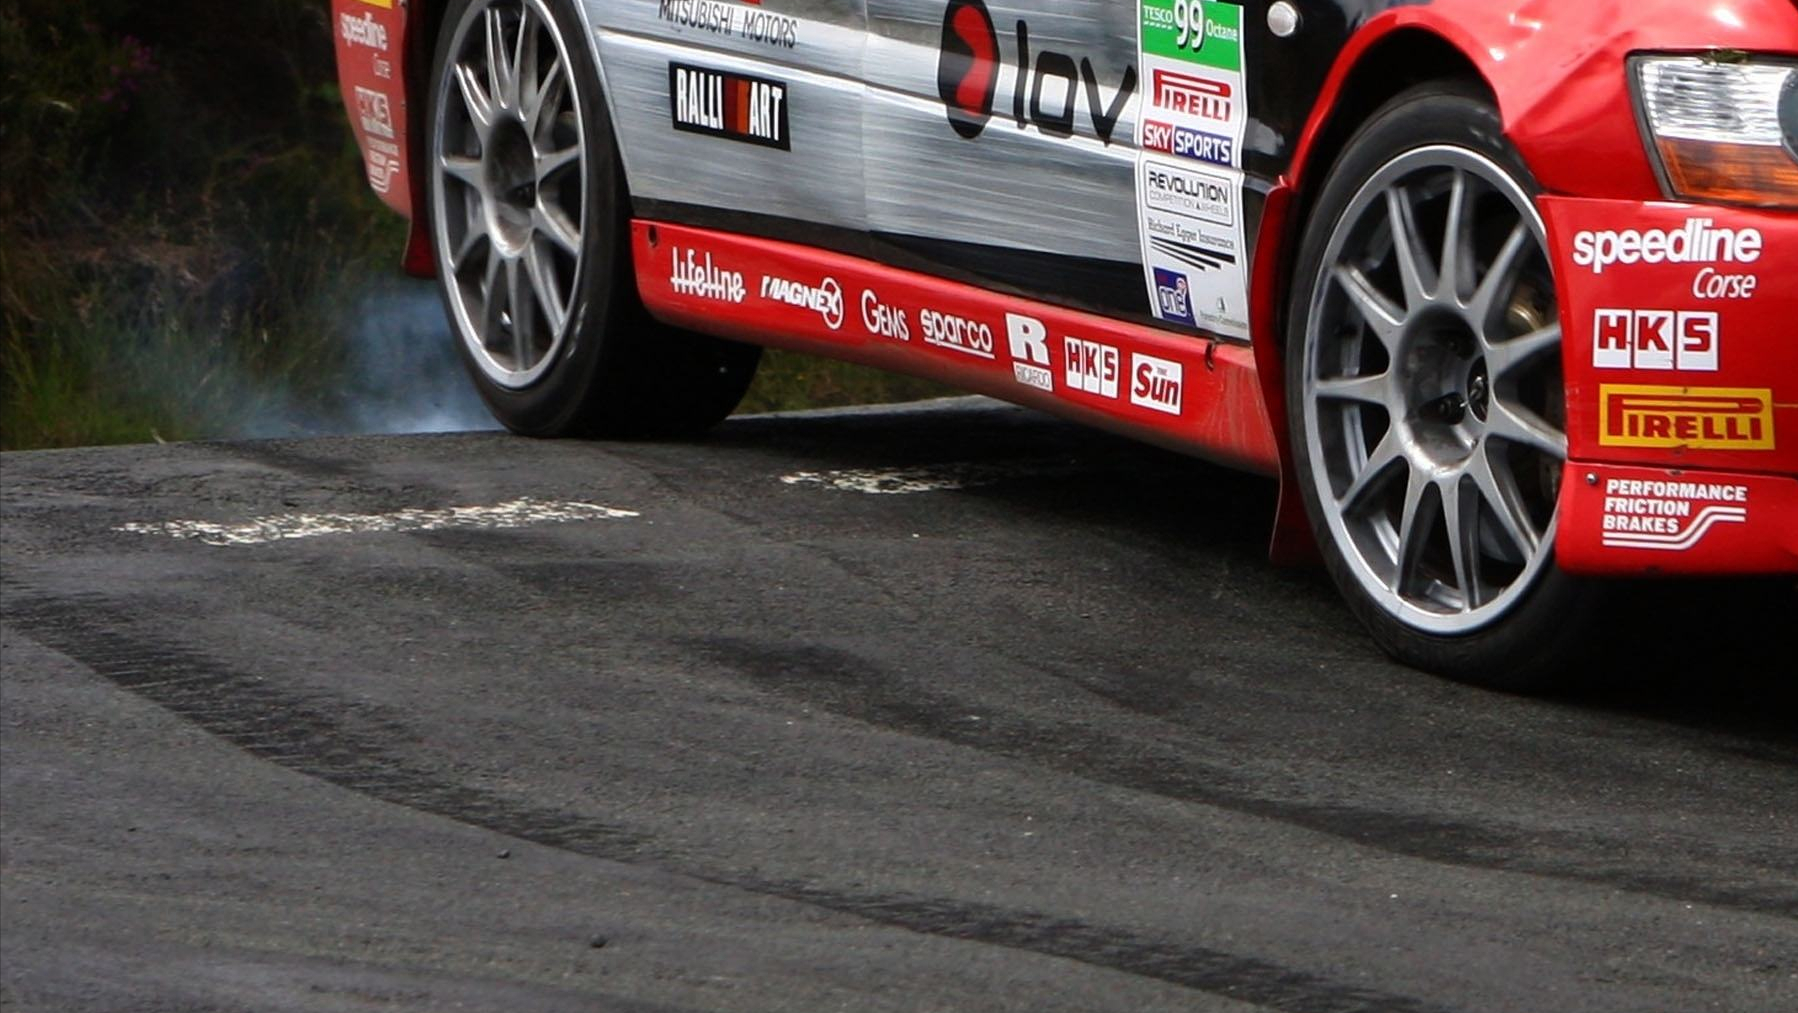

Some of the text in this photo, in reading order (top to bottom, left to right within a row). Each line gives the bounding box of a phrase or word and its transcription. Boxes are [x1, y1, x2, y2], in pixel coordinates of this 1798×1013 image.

[742, 10, 798, 49] MOTORS
[1143, 5, 1173, 25] TESCO
[1205, 19, 1237, 42] Octane
[1013, 19, 1137, 146] lov
[1153, 69, 1231, 122] PIRELLI
[676, 68, 782, 141] RALLI ART
[1144, 123, 1231, 163] SKY SPORTS
[1149, 171, 1228, 204] REVOLUTION
[1573, 218, 1762, 274] speedline
[670, 246, 746, 303] lifeline
[1693, 267, 1757, 299] Corse
[920, 308, 993, 354] sparco
[1005, 312, 1051, 366] R
[1598, 315, 1711, 352] HKS
[1067, 341, 1115, 382] HKS
[1134, 363, 1180, 406] Sun
[1607, 393, 1764, 441] PIRELLI
[1605, 496, 1690, 516] FRICTION
[1607, 479, 1748, 502] PERFORMANCE
[1603, 514, 1679, 533] BRAKES
